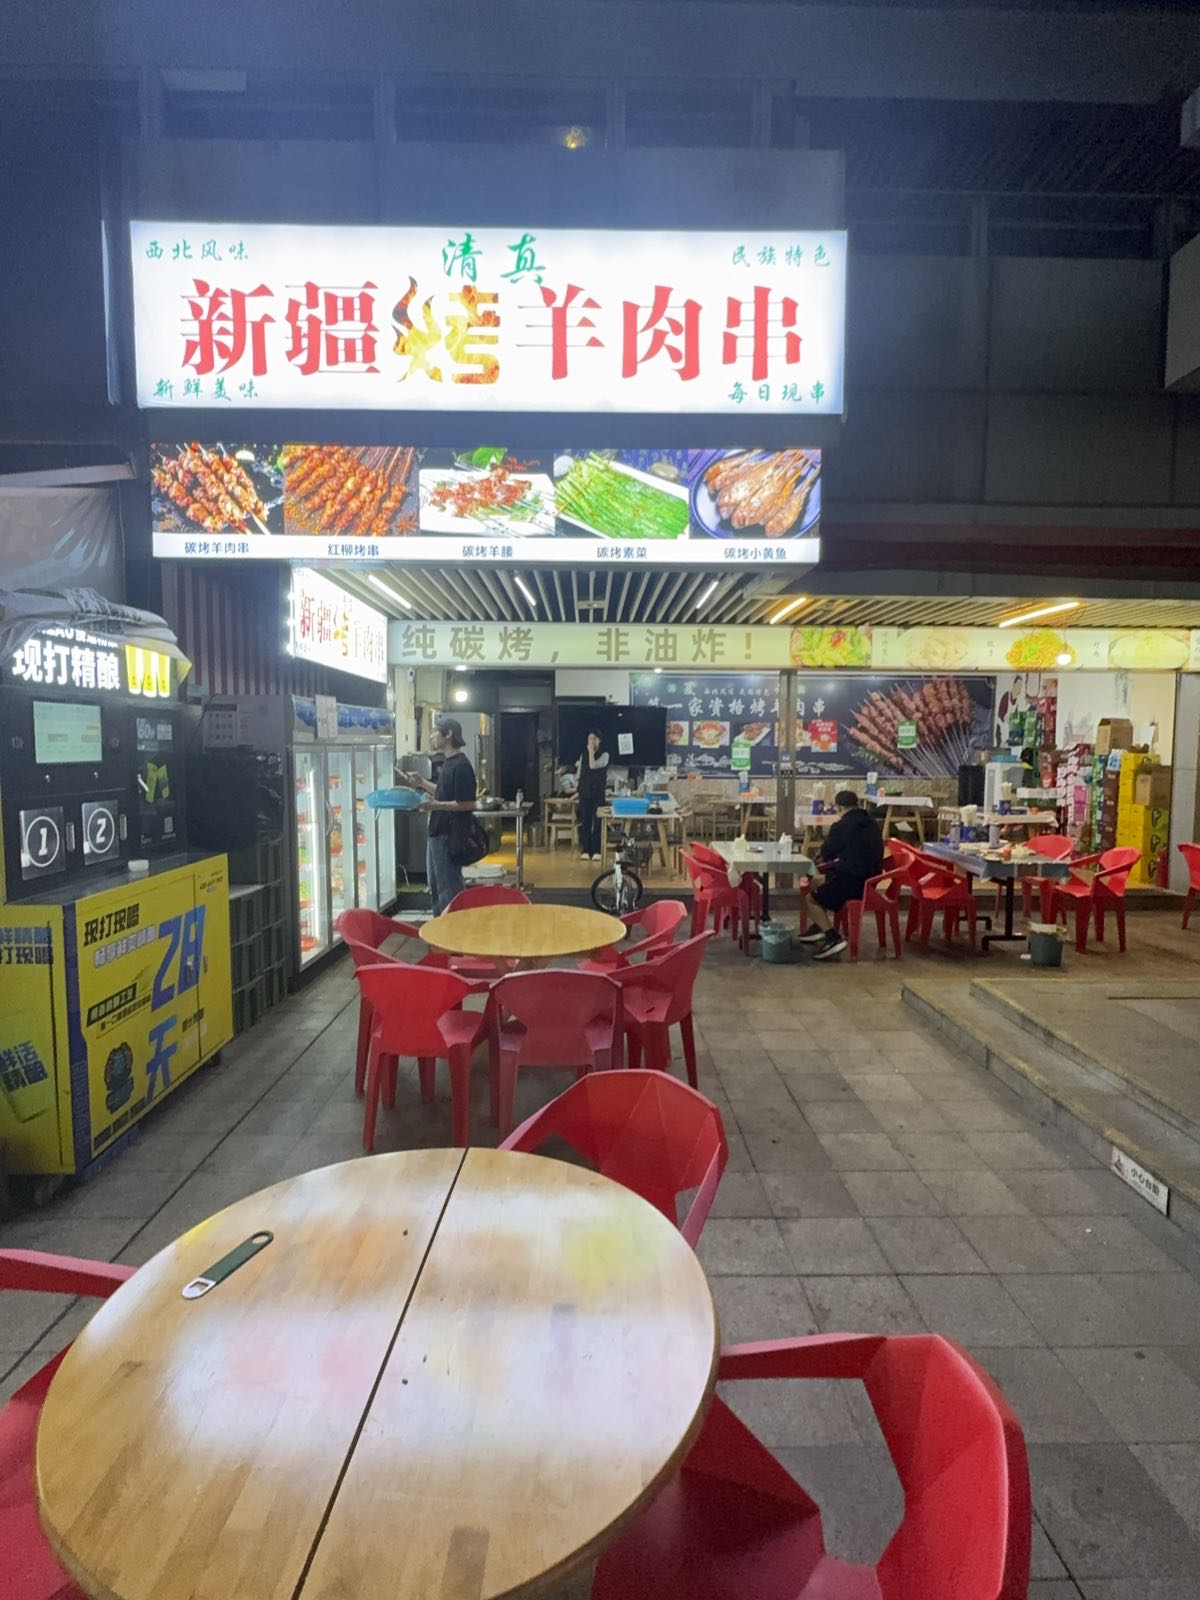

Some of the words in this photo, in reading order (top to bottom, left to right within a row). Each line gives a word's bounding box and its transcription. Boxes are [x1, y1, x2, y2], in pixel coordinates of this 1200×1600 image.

[146, 239, 249, 261] 西北风味
[441, 232, 546, 285] 清真
[732, 244, 831, 267] 民族特色
[180, 276, 803, 384] 新疆烤羊肉串
[152, 376, 259, 401] 新鲜美味
[728, 380, 826, 405] 每日现串
[184, 541, 250, 555] 碳烤羊肉串
[328, 544, 380, 557] 红柳烤串
[462, 545, 514, 558] 碳烤羊腰
[596, 546, 649, 559] 碳烤素菜
[723, 546, 788, 560] 碳烤小黄鱼
[12, 638, 121, 691] 现打精酿
[38, 827, 48, 857] 1
[95, 817, 108, 845] 2
